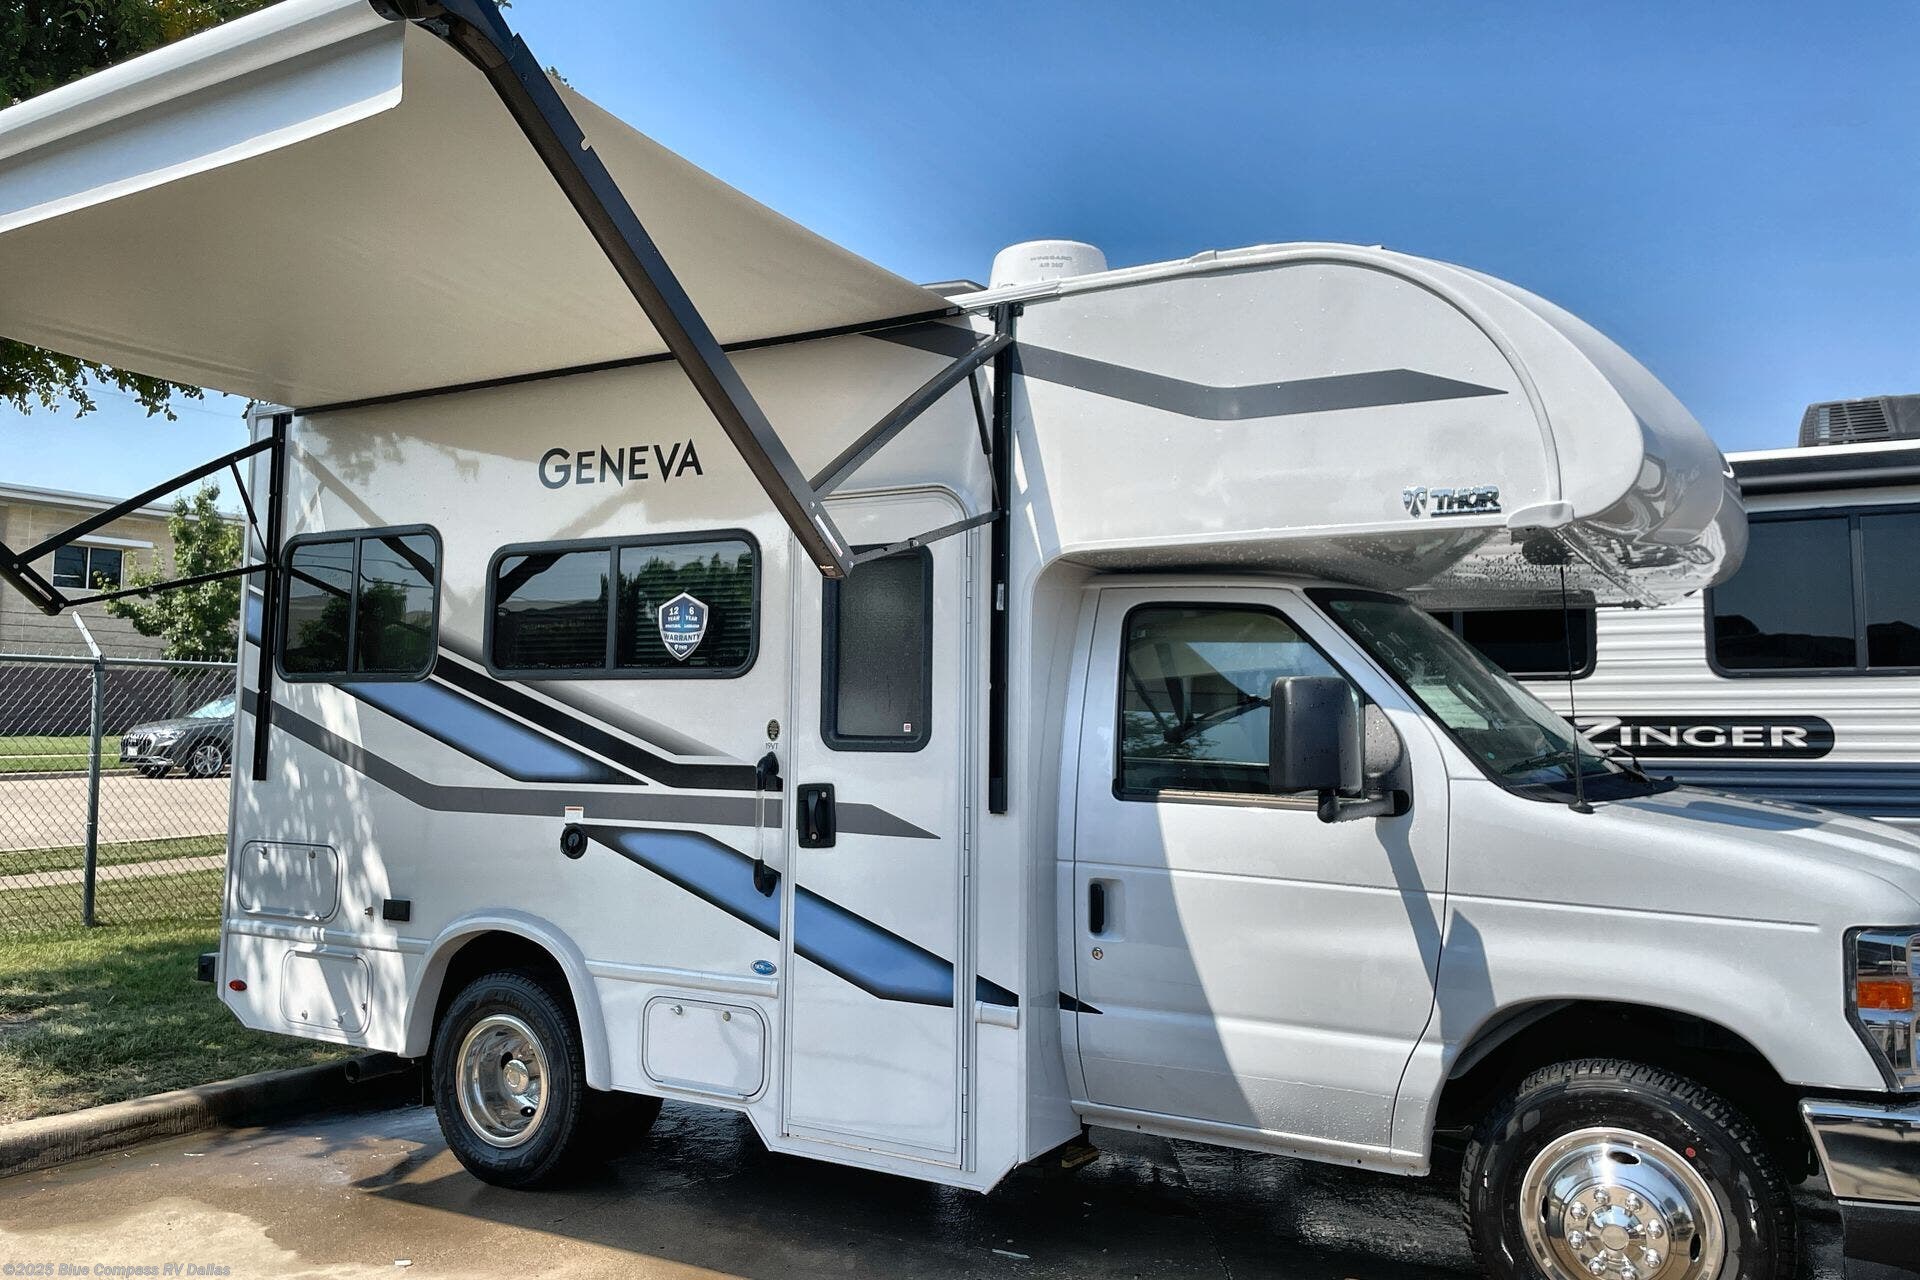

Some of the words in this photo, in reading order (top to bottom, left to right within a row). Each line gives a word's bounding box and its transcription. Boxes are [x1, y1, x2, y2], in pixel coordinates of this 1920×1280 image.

[538, 438, 704, 490] GENEVA
[1430, 485, 1502, 514] THOR
[669, 606, 680, 616] 12
[689, 606, 695, 615] 6
[663, 633, 700, 642] WARRANTY
[1575, 716, 1808, 750] ZINGER
